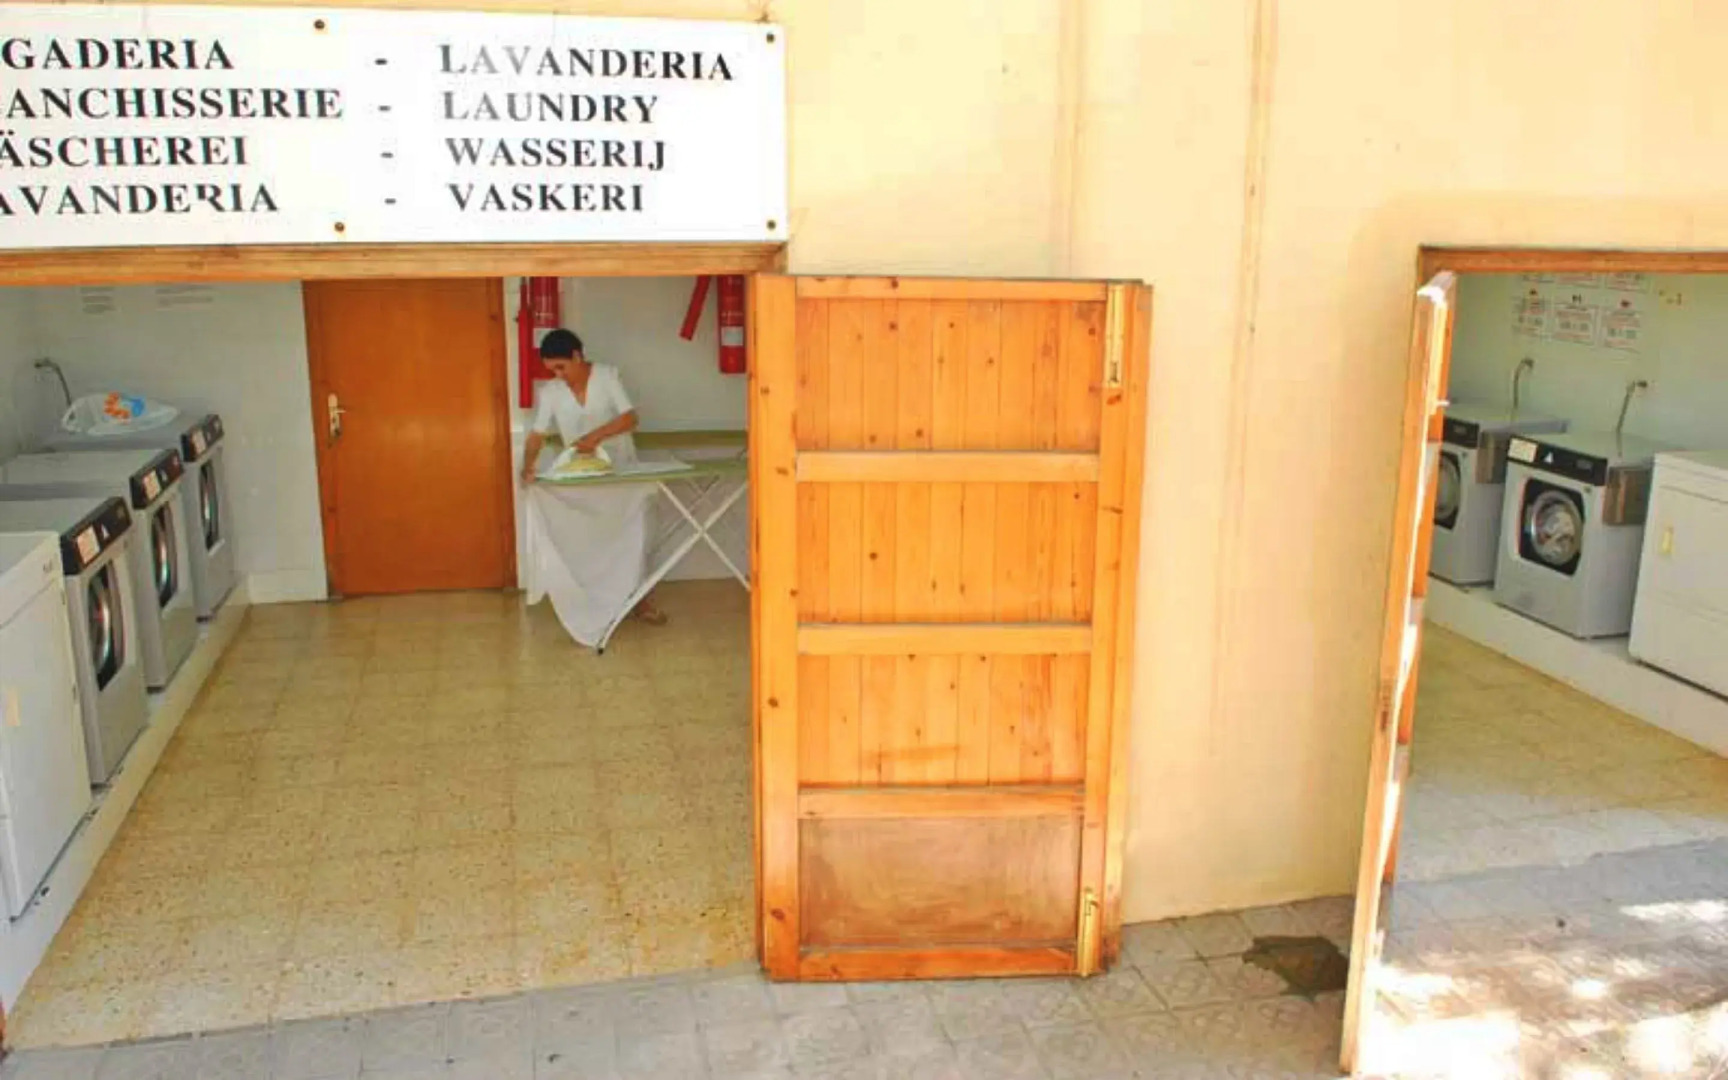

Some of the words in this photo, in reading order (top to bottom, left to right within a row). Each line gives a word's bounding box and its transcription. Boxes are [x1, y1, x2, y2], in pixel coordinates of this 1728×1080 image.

[1, 38, 234, 70] GADERIA
[440, 45, 733, 81] LAVANDERIA
[443, 91, 658, 123] LAUNDRY
[445, 137, 666, 171] WASSERIJ
[448, 183, 644, 212] VASKERI
